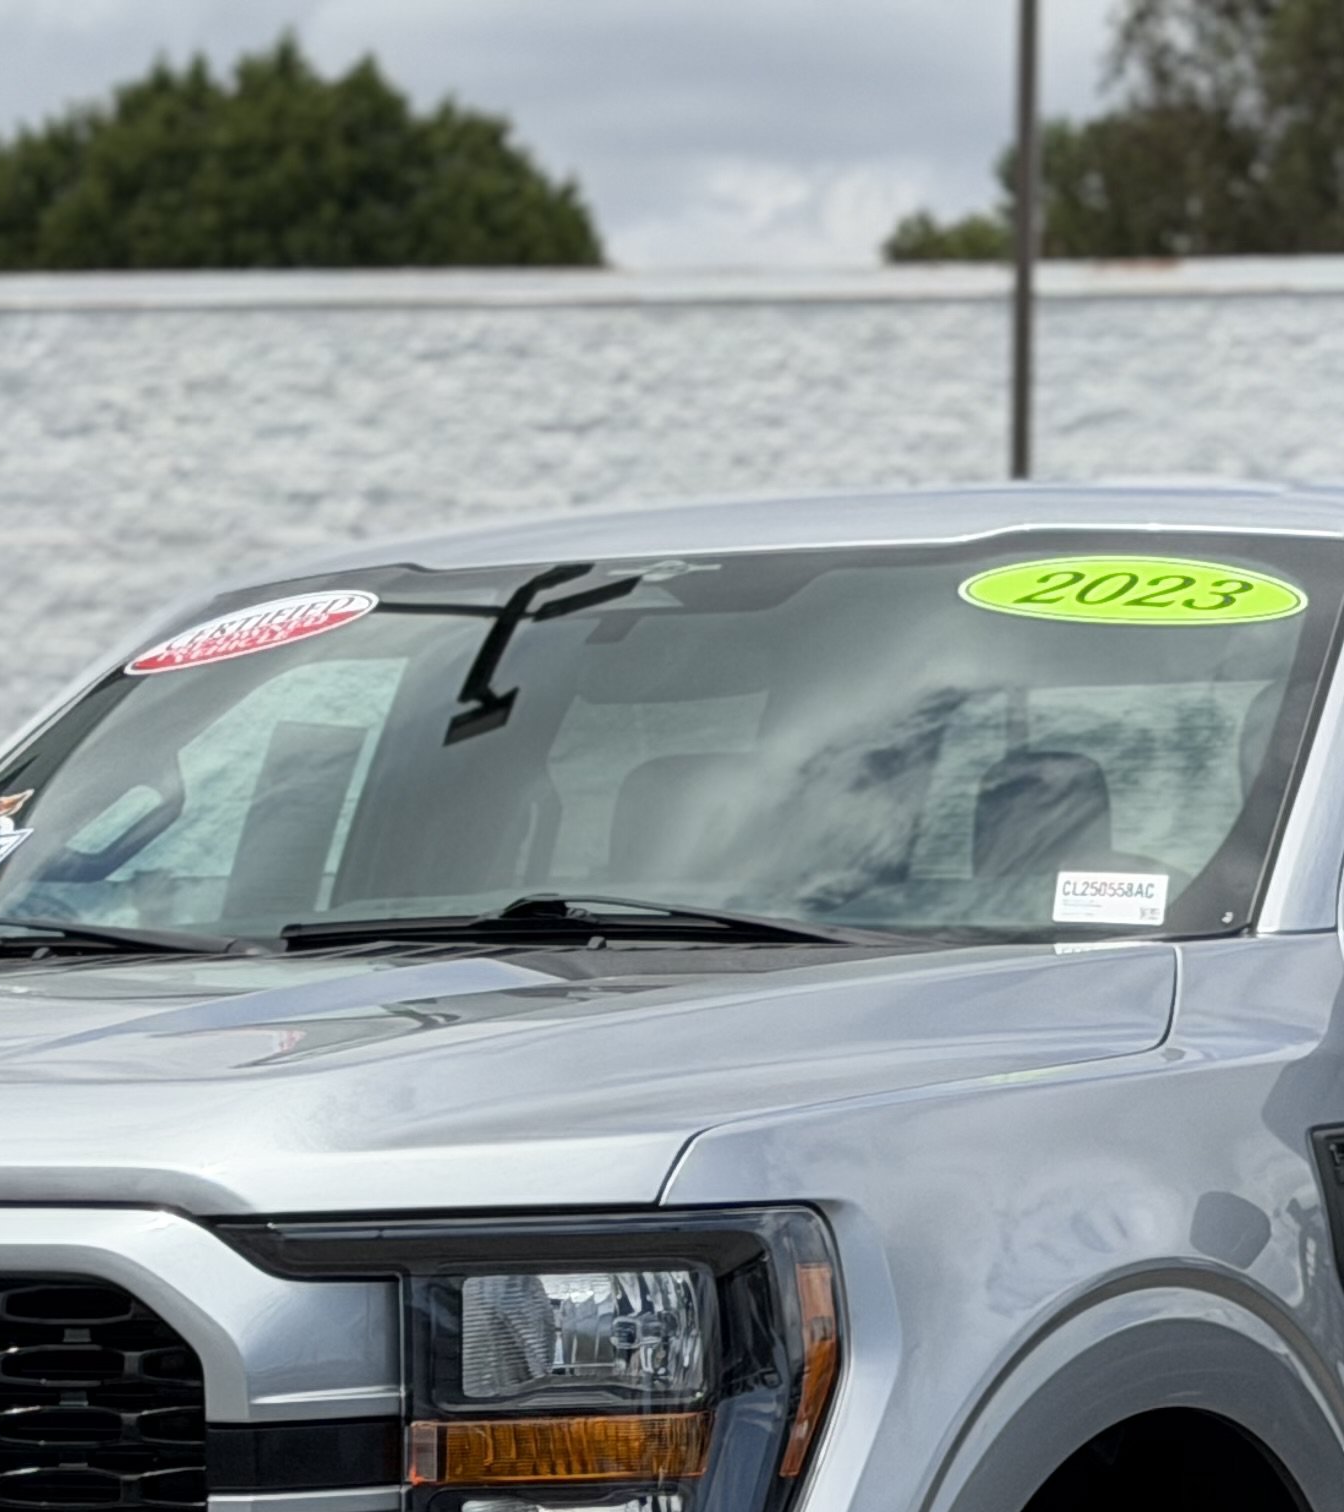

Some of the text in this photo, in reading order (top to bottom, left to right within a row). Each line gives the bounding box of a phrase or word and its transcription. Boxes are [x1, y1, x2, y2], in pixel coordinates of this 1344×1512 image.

[1012, 570, 1255, 611] 2023
[165, 597, 356, 651] CERTIFIED
[1062, 880, 1154, 899] CL250558AC
